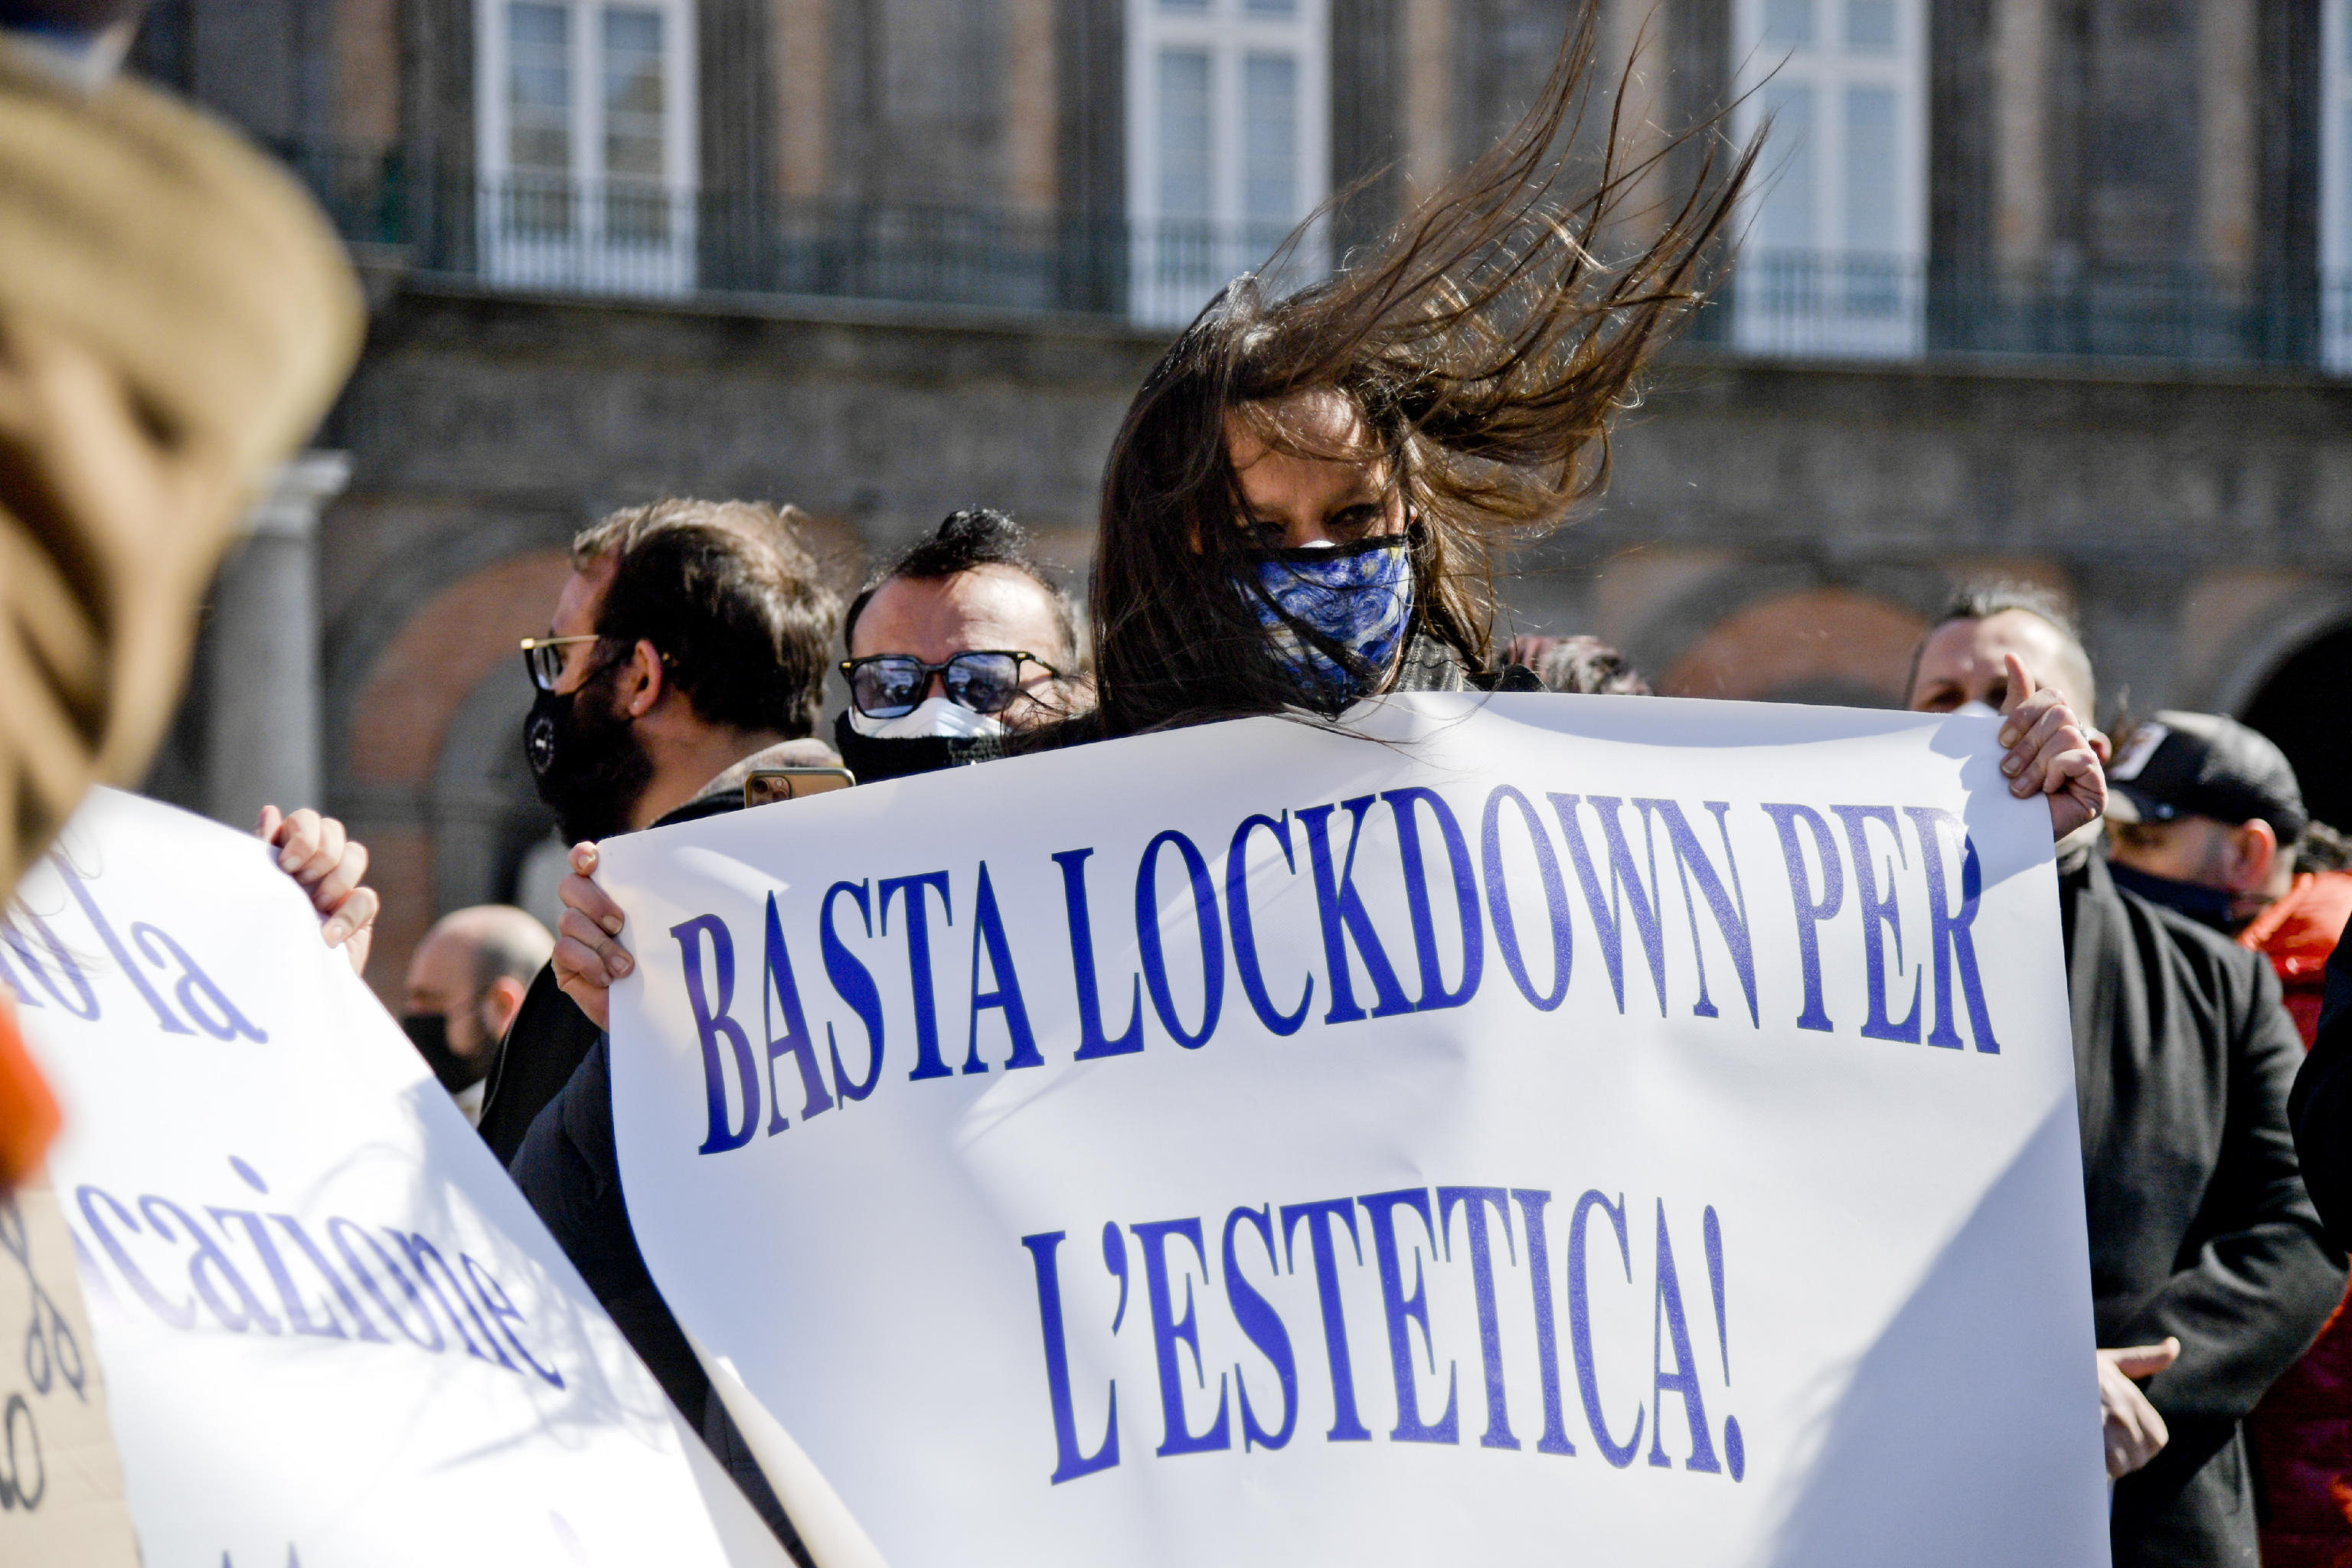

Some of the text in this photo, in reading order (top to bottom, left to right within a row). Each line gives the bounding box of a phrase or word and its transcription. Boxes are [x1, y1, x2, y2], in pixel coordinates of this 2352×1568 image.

[671, 786, 2001, 1155] BASTA LOCKDOWN PER
[67, 1155, 567, 1390] cazione
